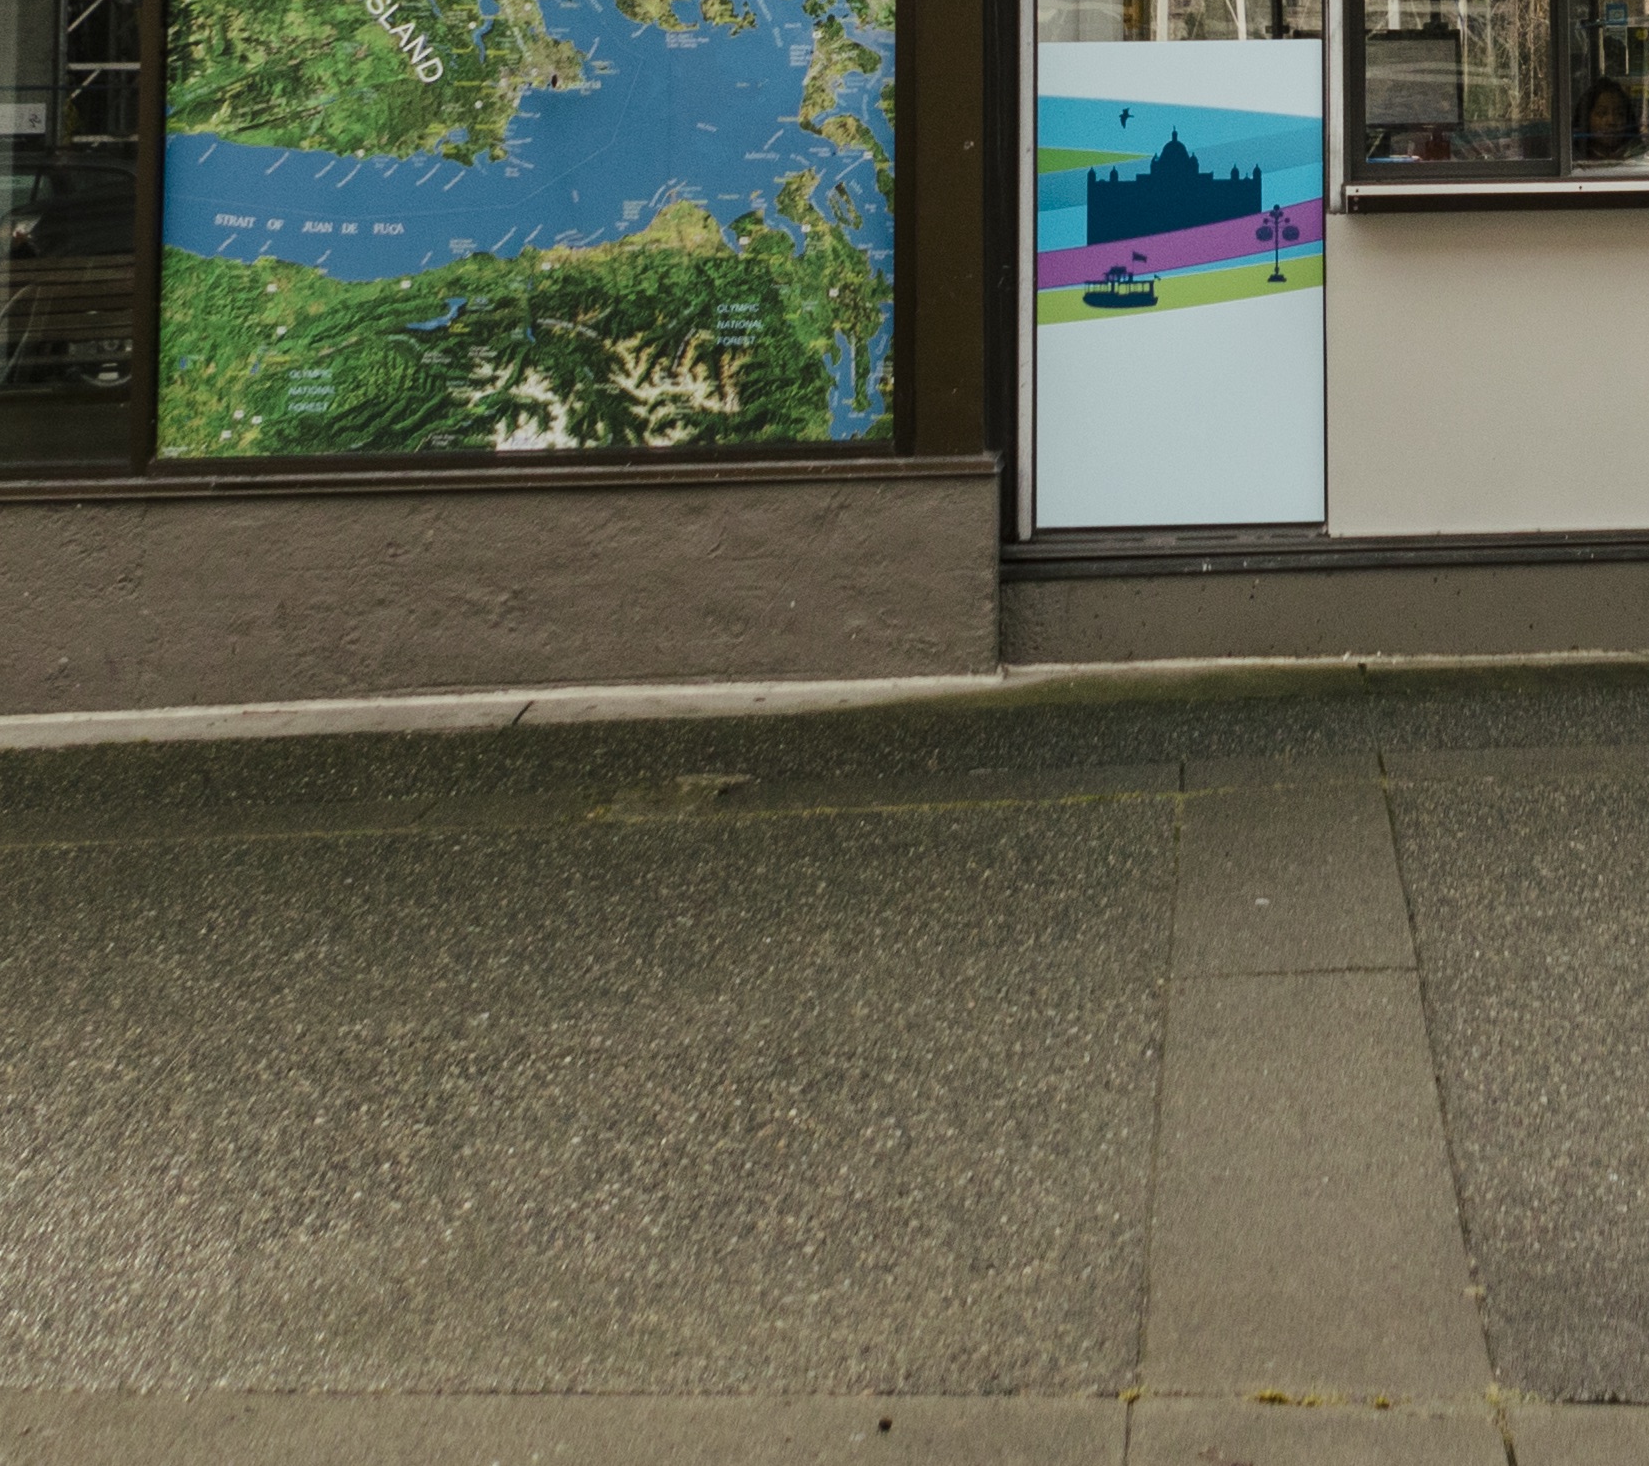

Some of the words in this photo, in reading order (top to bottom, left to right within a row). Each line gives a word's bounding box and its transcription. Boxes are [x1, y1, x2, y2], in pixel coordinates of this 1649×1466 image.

[214, 213, 256, 229] STRAIT
[267, 217, 285, 232] OF
[301, 220, 333, 234] JUAN
[341, 222, 358, 235] DE
[373, 223, 405, 236] FUCA
